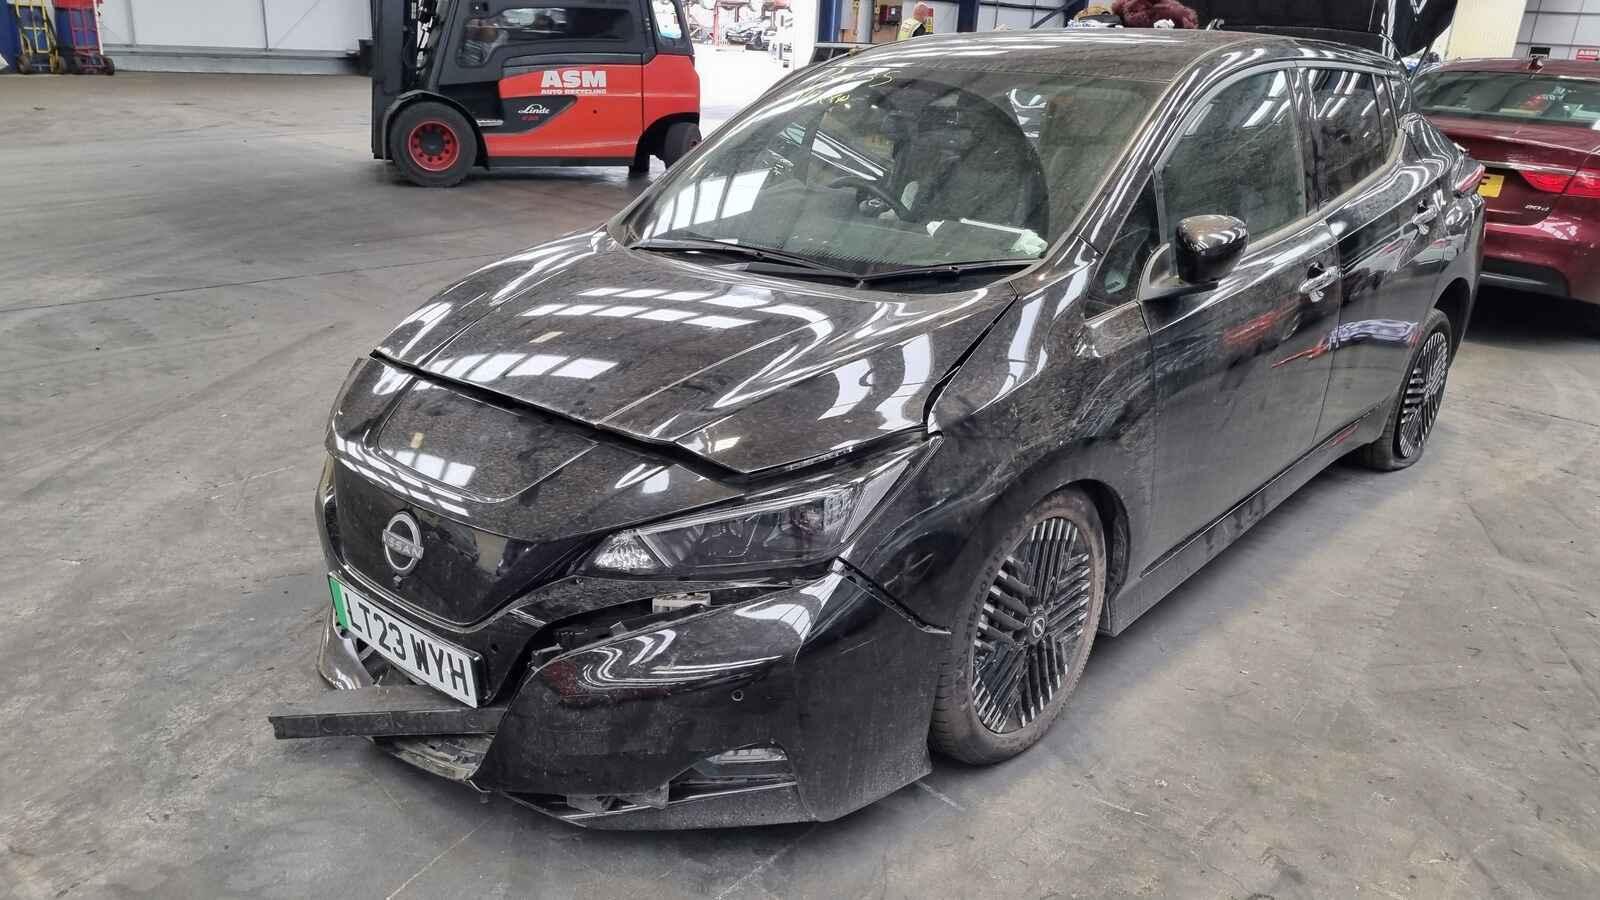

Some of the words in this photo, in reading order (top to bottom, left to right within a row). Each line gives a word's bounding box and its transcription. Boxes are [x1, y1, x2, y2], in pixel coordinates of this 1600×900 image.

[541, 70, 607, 88] ASM
[518, 103, 550, 114] Linde
[345, 593, 407, 661] LT23
[410, 633, 469, 697] WYH
